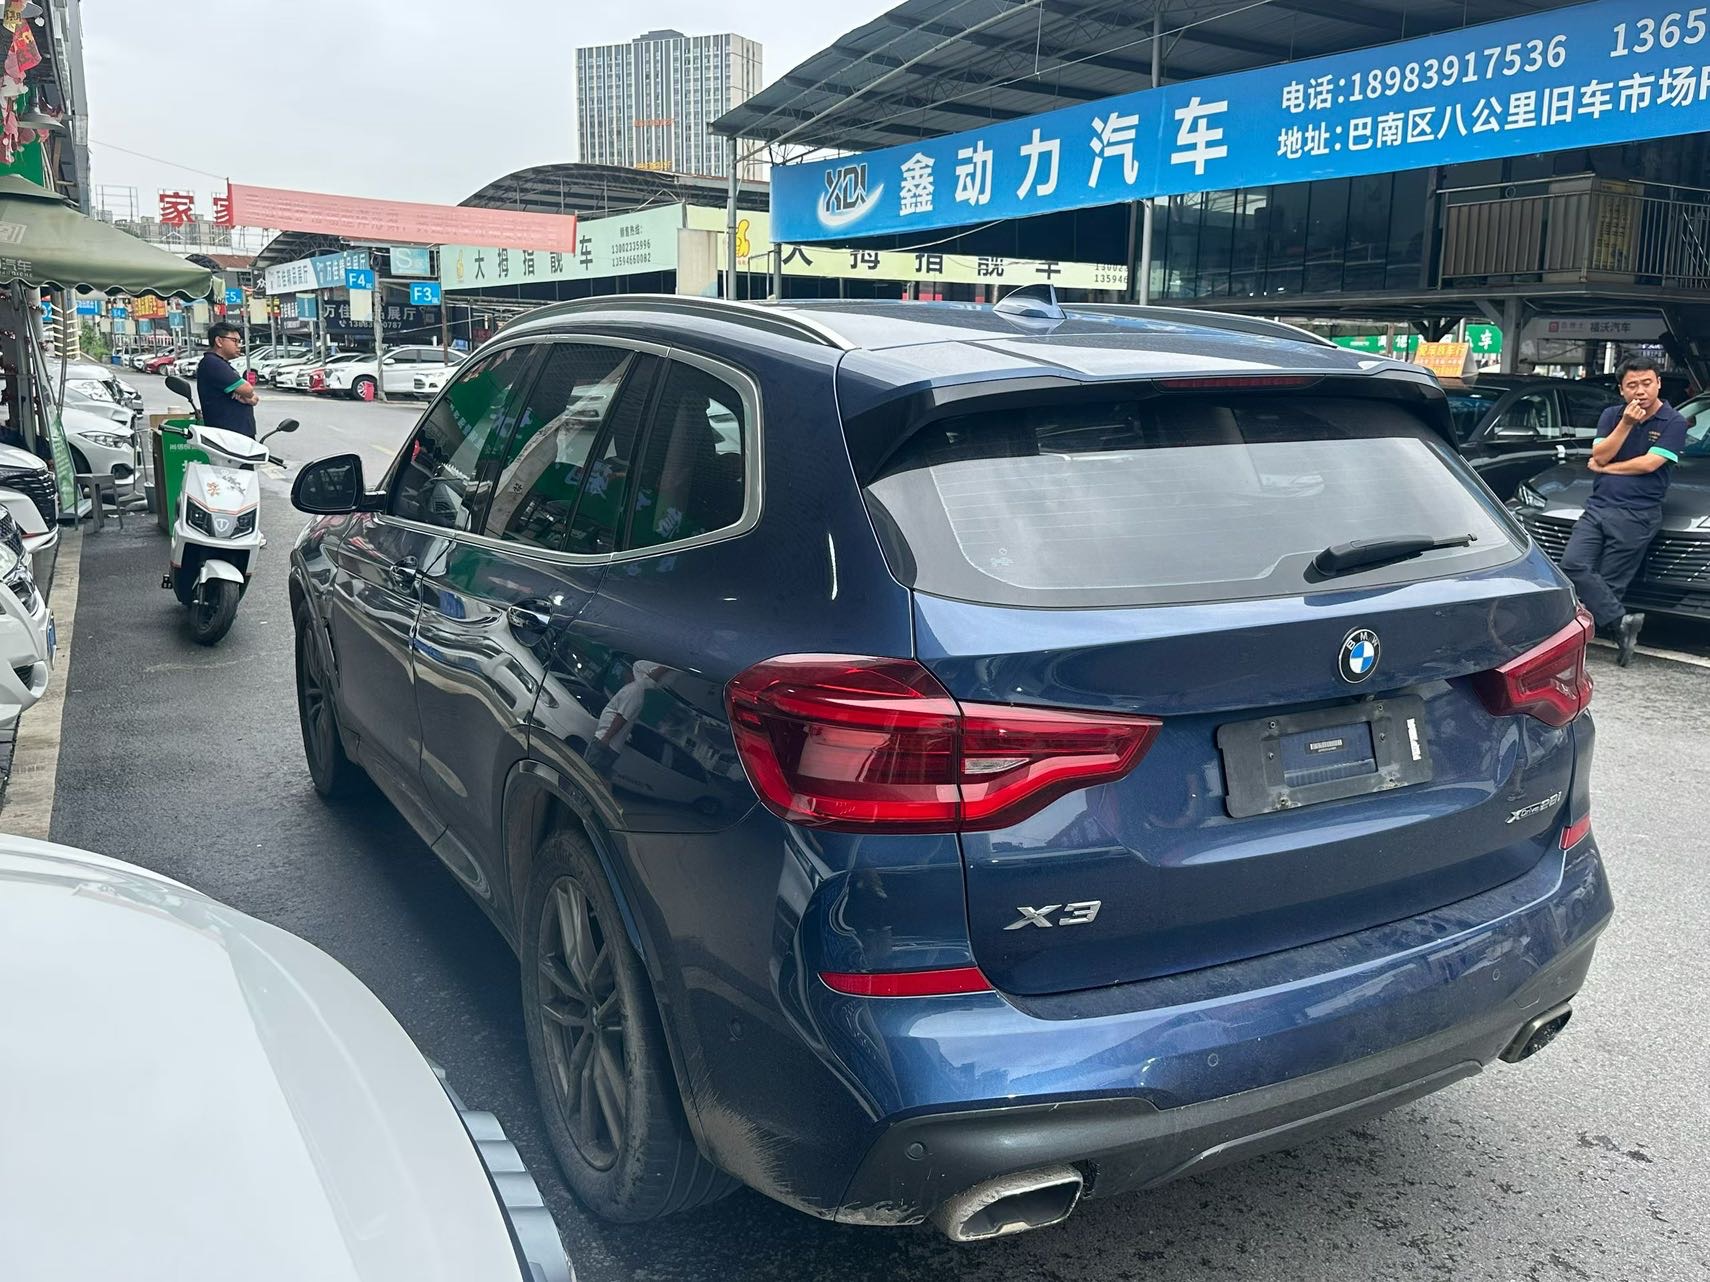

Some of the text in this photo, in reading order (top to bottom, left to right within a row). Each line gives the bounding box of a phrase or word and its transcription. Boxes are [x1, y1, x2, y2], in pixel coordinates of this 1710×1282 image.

[1281, 8, 1708, 115] 电话:18983917536 1365
[899, 96, 1229, 217] 鑫动力汽车
[0, 258, 32, 273] 汽车
[323, 304, 417, 321] 万佳展厅
[1003, 899, 1102, 931] X3
